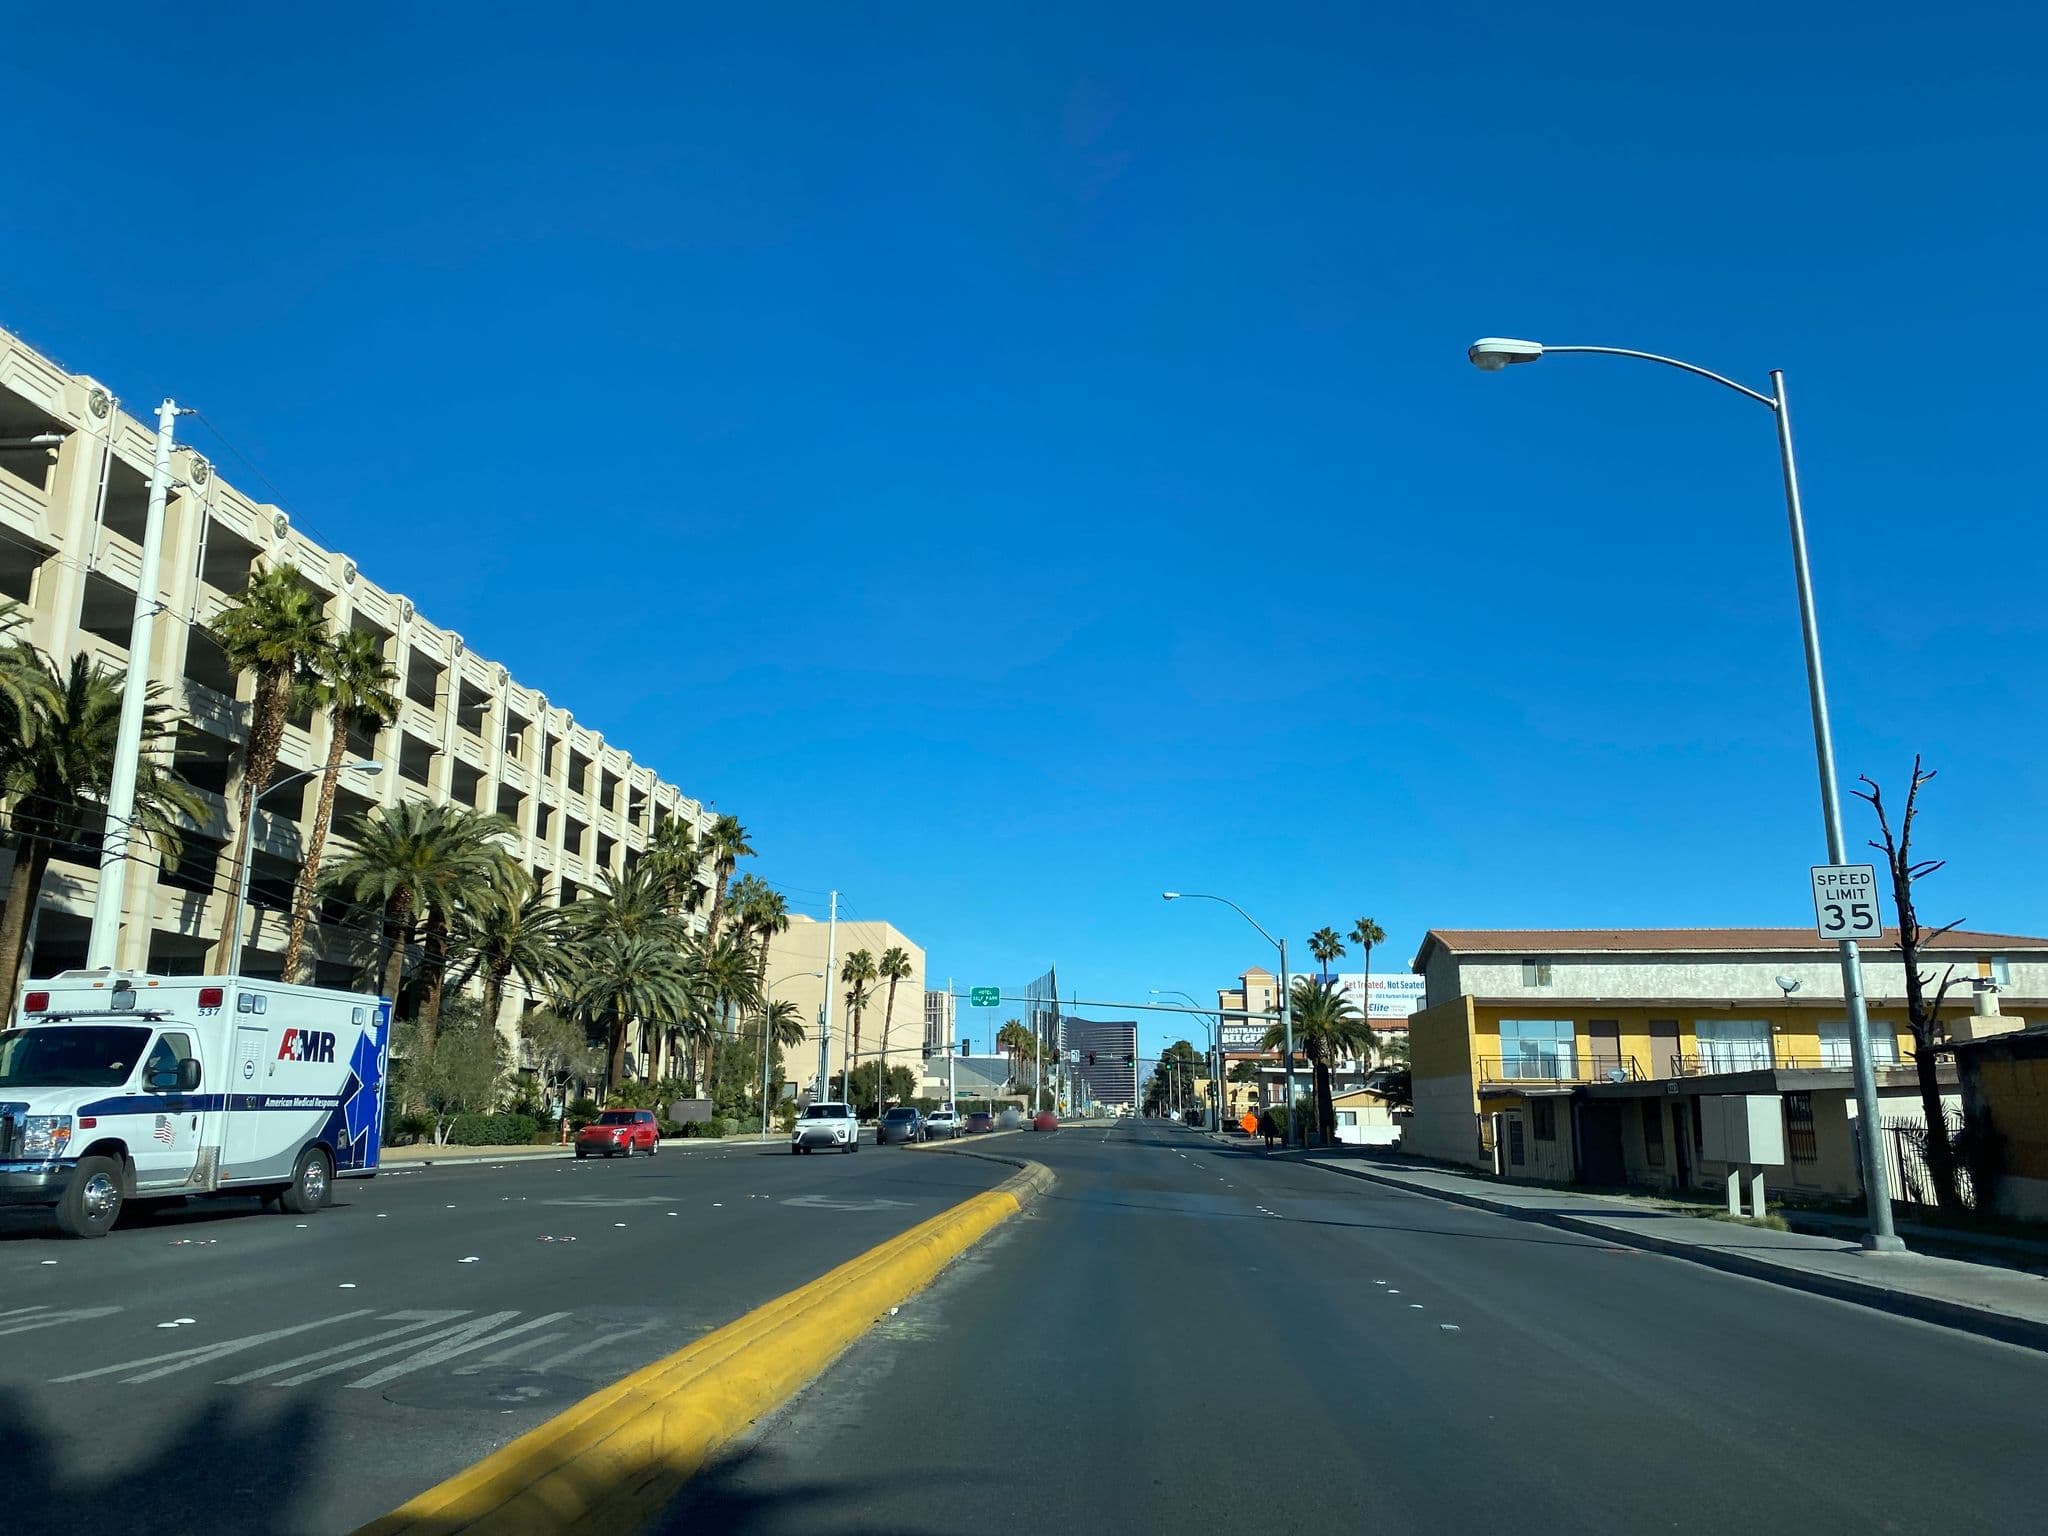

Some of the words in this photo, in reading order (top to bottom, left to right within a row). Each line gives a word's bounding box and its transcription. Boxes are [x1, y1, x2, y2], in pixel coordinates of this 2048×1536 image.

[1817, 873, 1870, 885] SPEED
[1826, 888, 1866, 900] LIMIT
[1823, 903, 1874, 931] 35
[1344, 980, 1356, 990] Get
[1357, 980, 1386, 990] Trated,
[1387, 980, 1400, 989] Not
[1400, 980, 1425, 989] Seated
[198, 1008, 221, 1017] 537
[1368, 1003, 1390, 1012] Elite
[1221, 1033, 1242, 1044] BEE
[1242, 1033, 1264, 1043] GEE
[277, 1028, 336, 1063] AMR
[265, 1097, 292, 1107] American
[293, 1097, 315, 1107] Medical
[315, 1097, 339, 1109] Response
